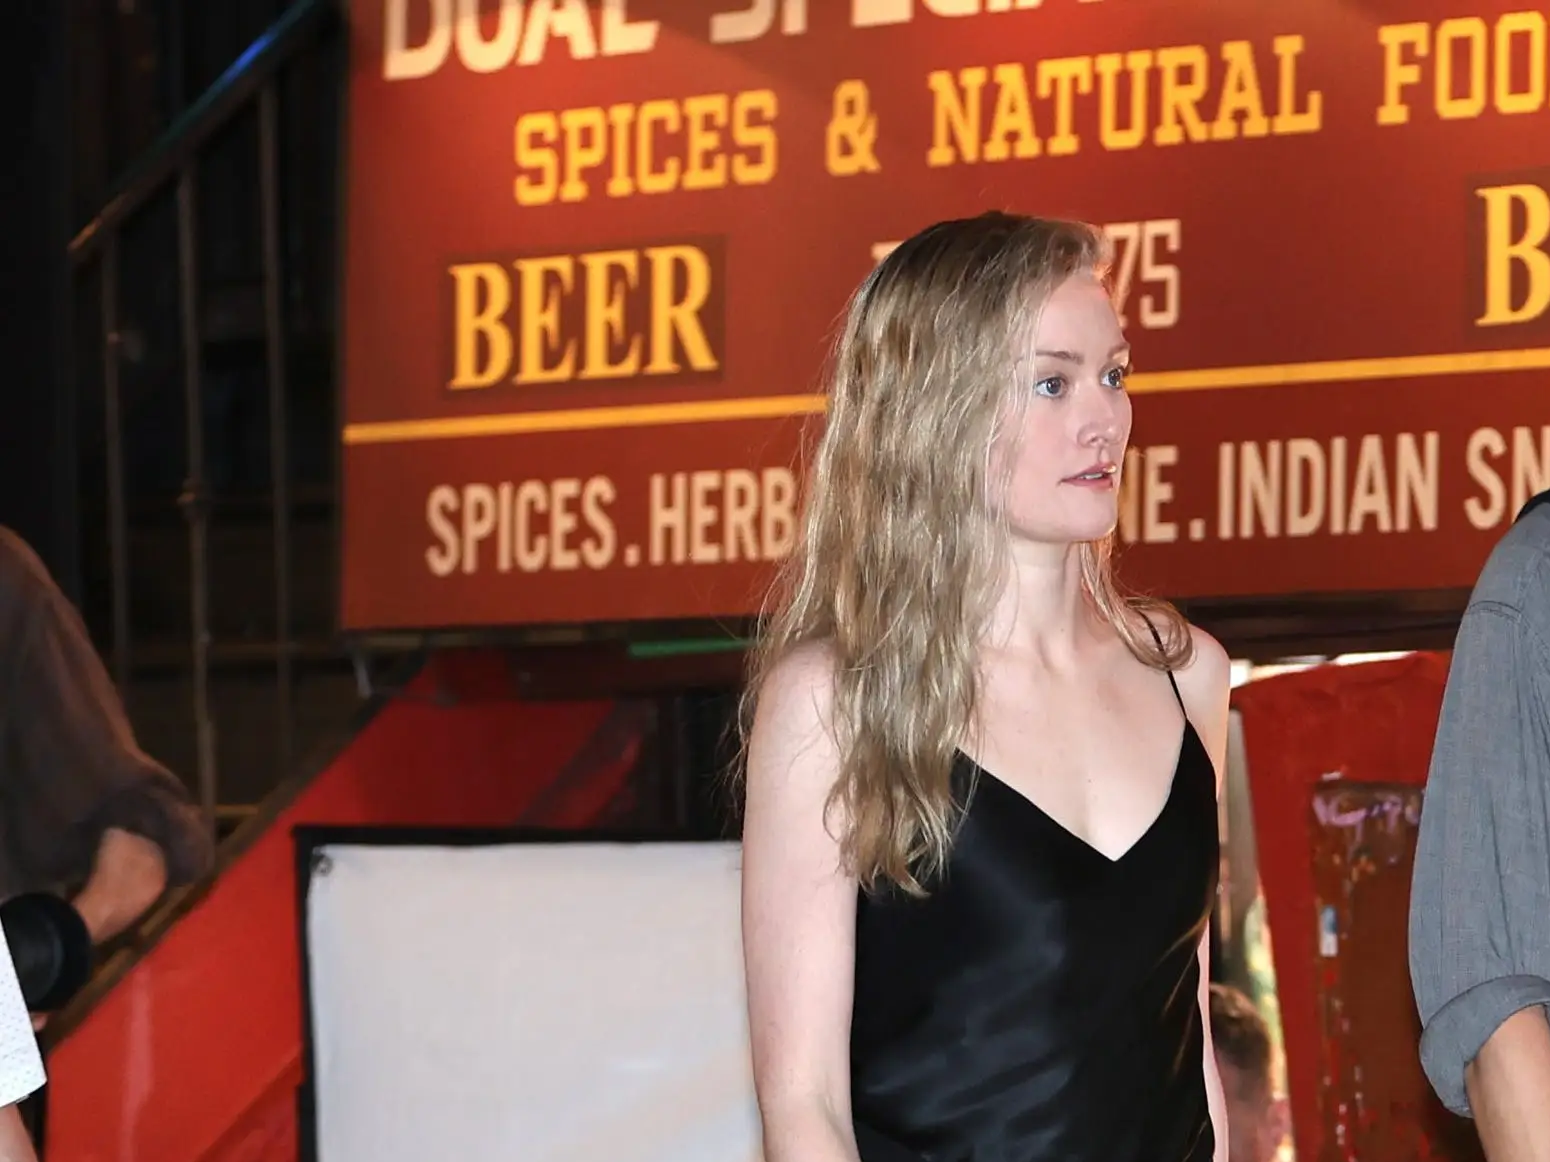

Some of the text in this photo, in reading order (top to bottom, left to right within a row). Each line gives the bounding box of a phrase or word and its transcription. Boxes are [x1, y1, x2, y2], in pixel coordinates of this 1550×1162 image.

[514, 90, 778, 206] SPICES
[825, 79, 881, 176] &
[927, 34, 1323, 167] NATURAL
[447, 244, 718, 391] BEER
[648, 466, 799, 566] HERB
[1216, 430, 1440, 541] INDIAN
